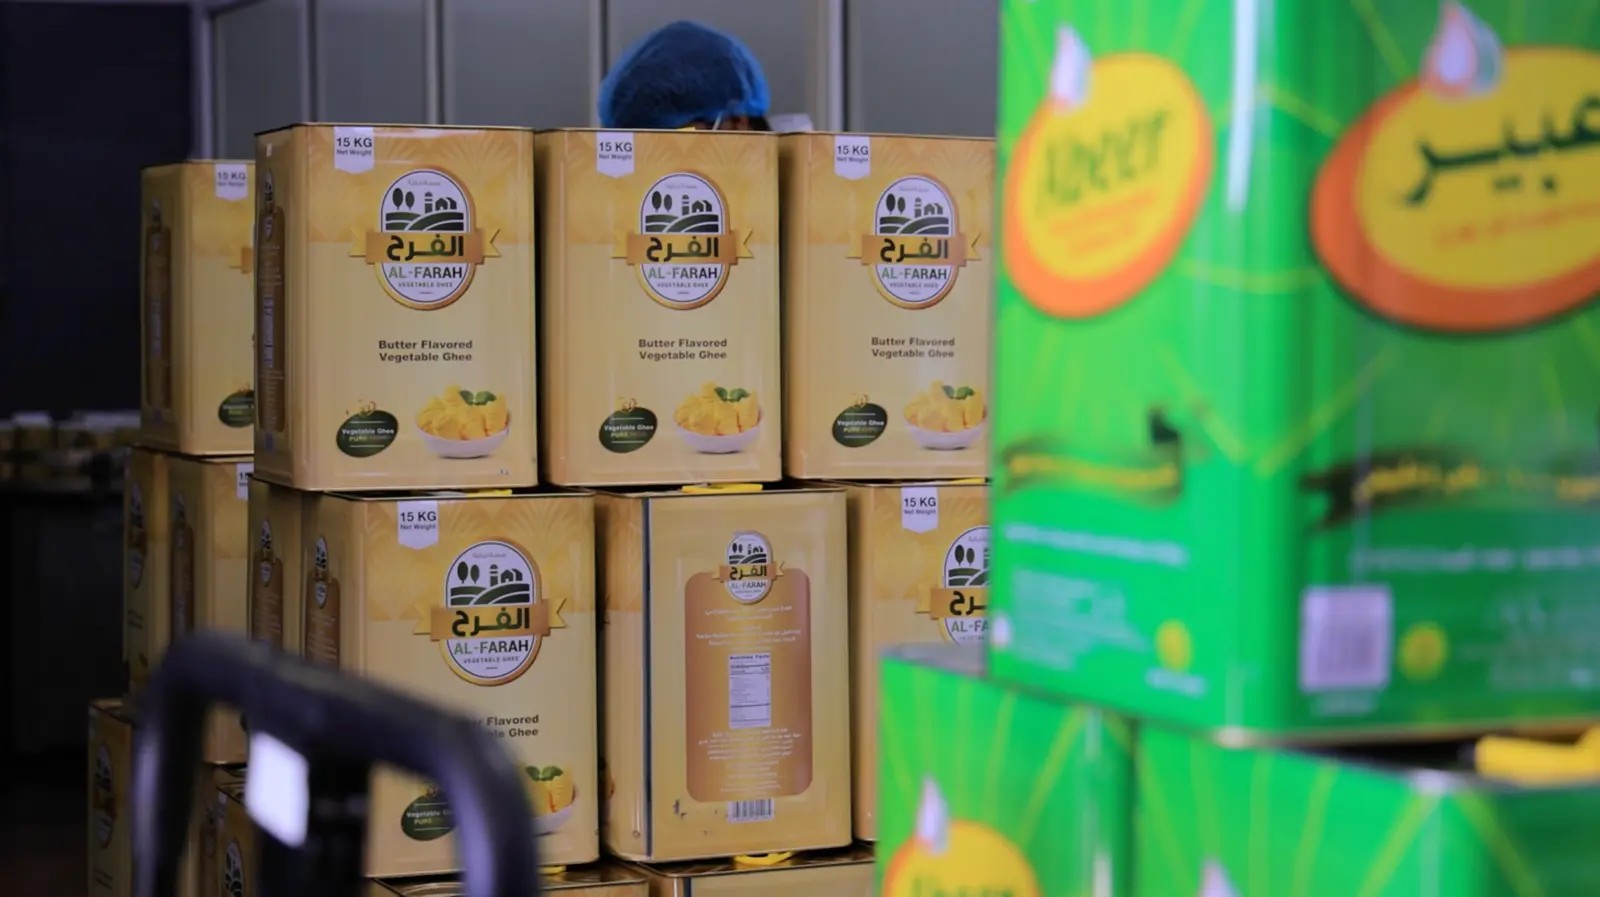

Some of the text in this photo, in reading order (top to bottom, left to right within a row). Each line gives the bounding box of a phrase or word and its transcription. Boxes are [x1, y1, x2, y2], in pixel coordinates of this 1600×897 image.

[336, 137, 373, 148] 15 KG
[599, 141, 633, 152] 15 KG
[837, 145, 869, 155] 15 KG
[386, 233, 464, 261] الفرح
[646, 235, 719, 263] الفرح
[880, 237, 948, 263] الفرح
[388, 266, 463, 279] AL-FARAH
[648, 267, 718, 279] AL-FARAH
[881, 268, 947, 279] AL-FARAH
[378, 340, 473, 350] Butter Flavored
[638, 338, 728, 348] Butter Flavored
[871, 337, 956, 346] Butter Flavored
[379, 352, 473, 364] Vegetable Ghee
[639, 350, 727, 362] Vegetable Ghee
[872, 349, 955, 359] Vegetable Ghee
[341, 428, 376, 436] Vegetable
[604, 424, 636, 432] Vegetable
[904, 497, 937, 507] 15 KG
[400, 511, 437, 522] 15 KG
[729, 565, 767, 580] الفرح
[452, 607, 530, 636] الفرح
[952, 621, 989, 632] AL-FA
[454, 639, 529, 655] AL-FARAH
[486, 714, 539, 726] Flavored
[508, 728, 539, 737] Ghee
